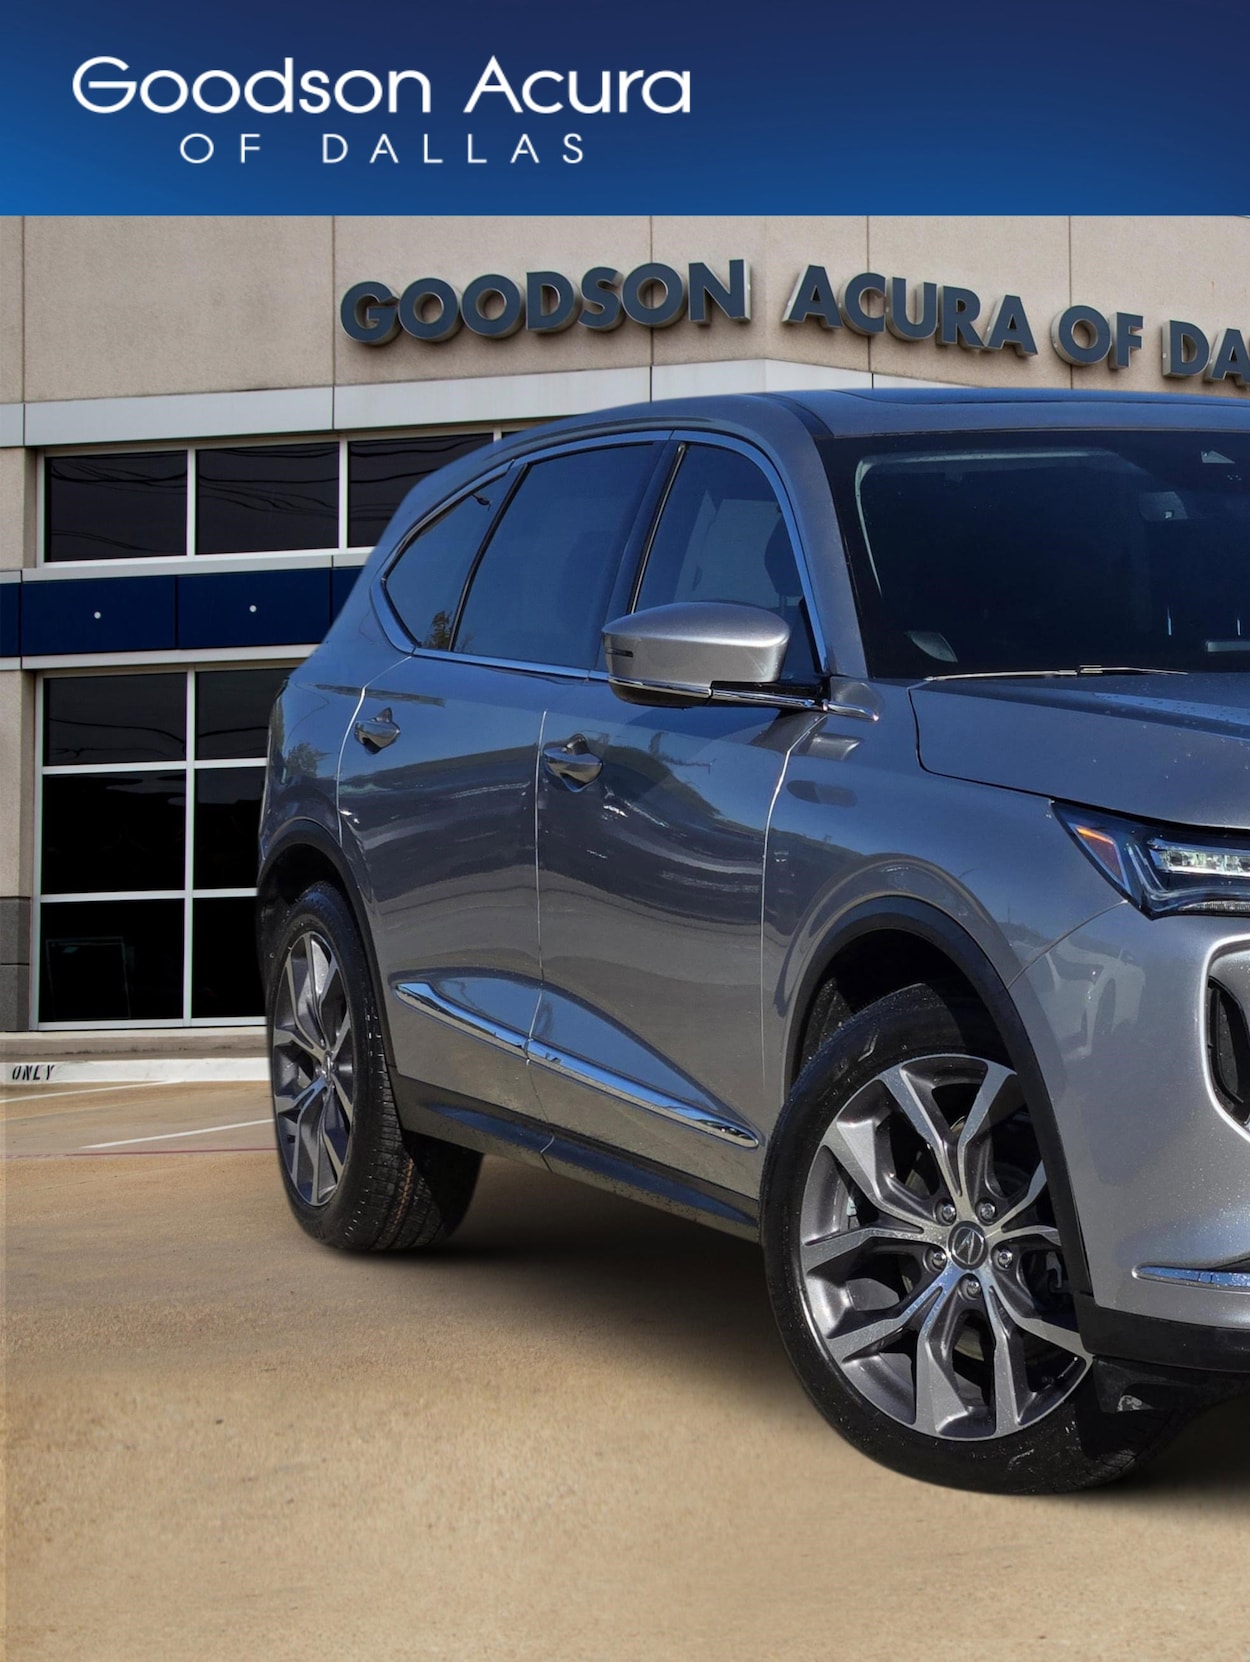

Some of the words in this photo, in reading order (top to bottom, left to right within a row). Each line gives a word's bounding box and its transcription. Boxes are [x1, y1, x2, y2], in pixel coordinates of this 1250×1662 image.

[340, 259, 751, 346] GOODSON
[782, 264, 1038, 358] ACURA
[1050, 305, 1144, 370] OF
[12, 1064, 55, 1080] ONLY
